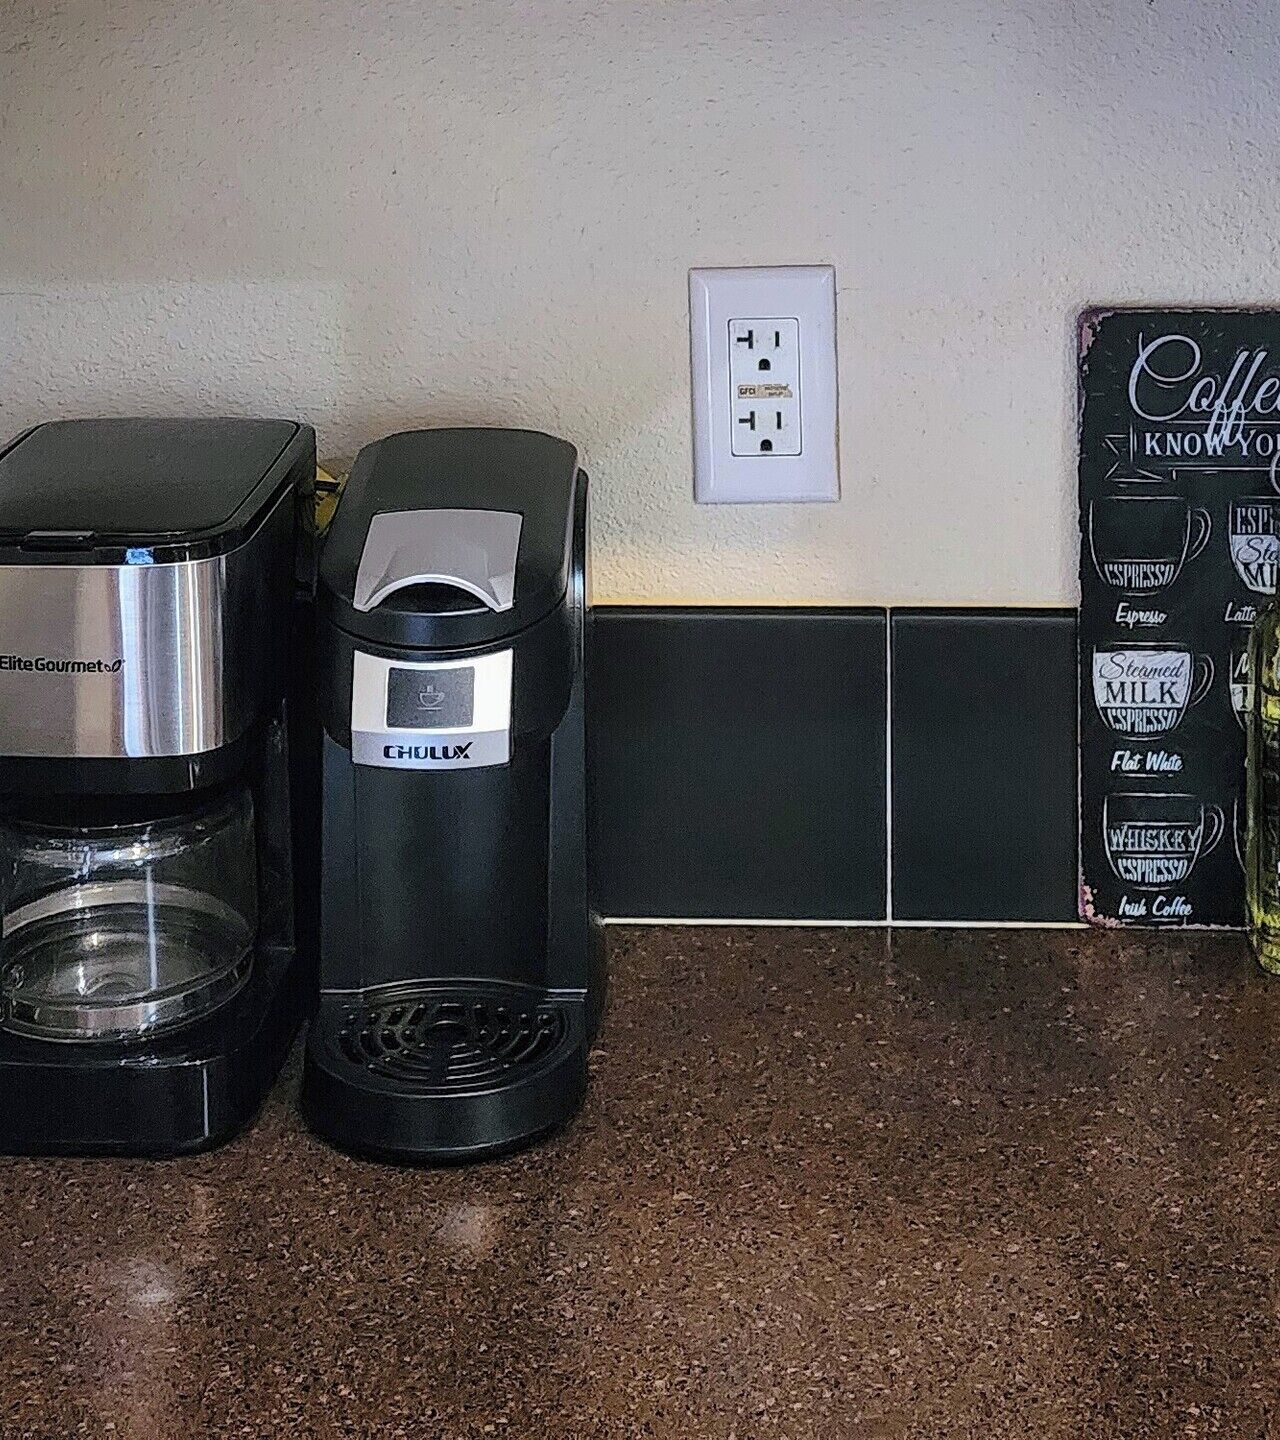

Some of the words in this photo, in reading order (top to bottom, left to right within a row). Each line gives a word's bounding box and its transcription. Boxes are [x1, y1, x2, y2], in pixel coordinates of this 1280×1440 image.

[1144, 432, 1225, 457] KNOW
[1104, 564, 1174, 588] ESPRESSO
[1115, 603, 1167, 629] Espresso
[1099, 652, 1184, 679] Steamed
[1103, 682, 1181, 704] MILK
[1107, 709, 1178, 733] ESPRESSO
[383, 741, 473, 760] CHULUX
[1111, 751, 1143, 771] Flat
[1146, 751, 1184, 771] White
[1108, 826, 1203, 851] WHISKEY
[1117, 858, 1188, 882] ESPRESSO
[1151, 895, 1193, 916] Coffee
